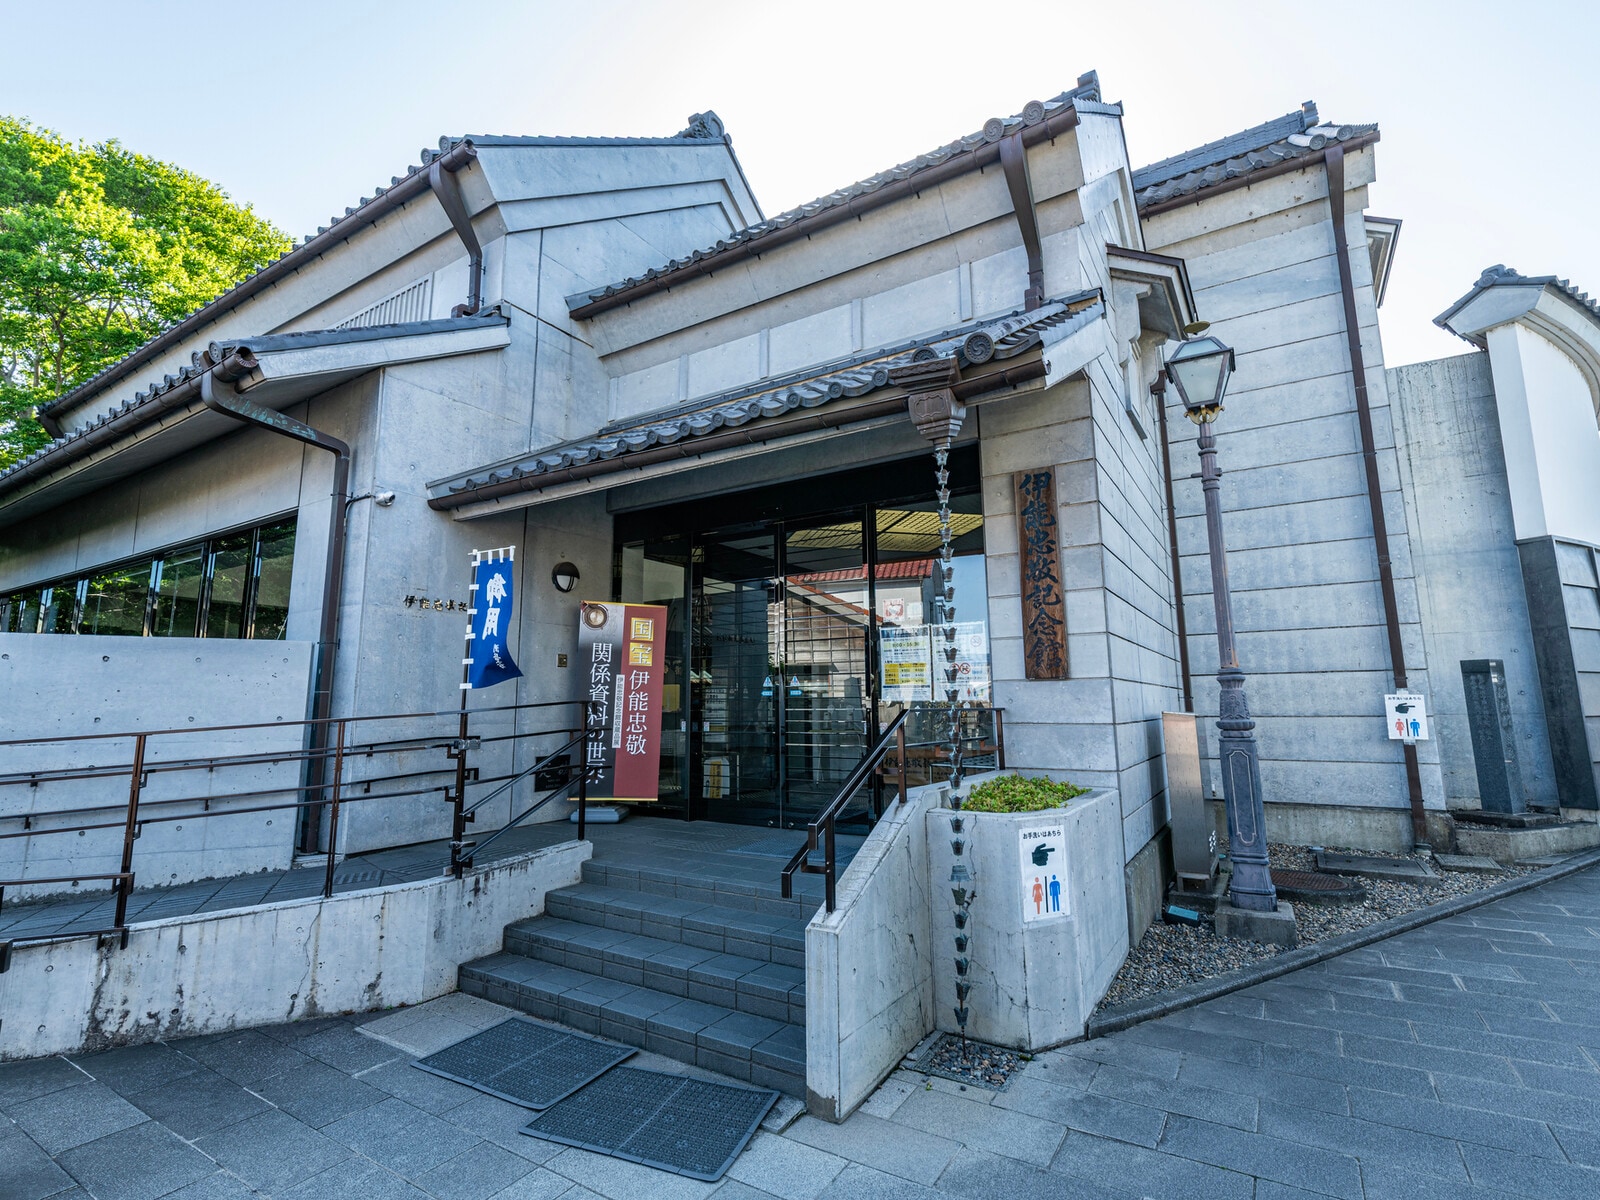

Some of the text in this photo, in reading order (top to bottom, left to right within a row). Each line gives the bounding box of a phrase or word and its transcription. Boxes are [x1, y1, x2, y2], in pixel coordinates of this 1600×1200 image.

[1019, 471, 1064, 670] 伊能忠敬記念館
[625, 670, 650, 755] 伊能忠敬
[1023, 830, 1062, 840] お手洗いはあちら
